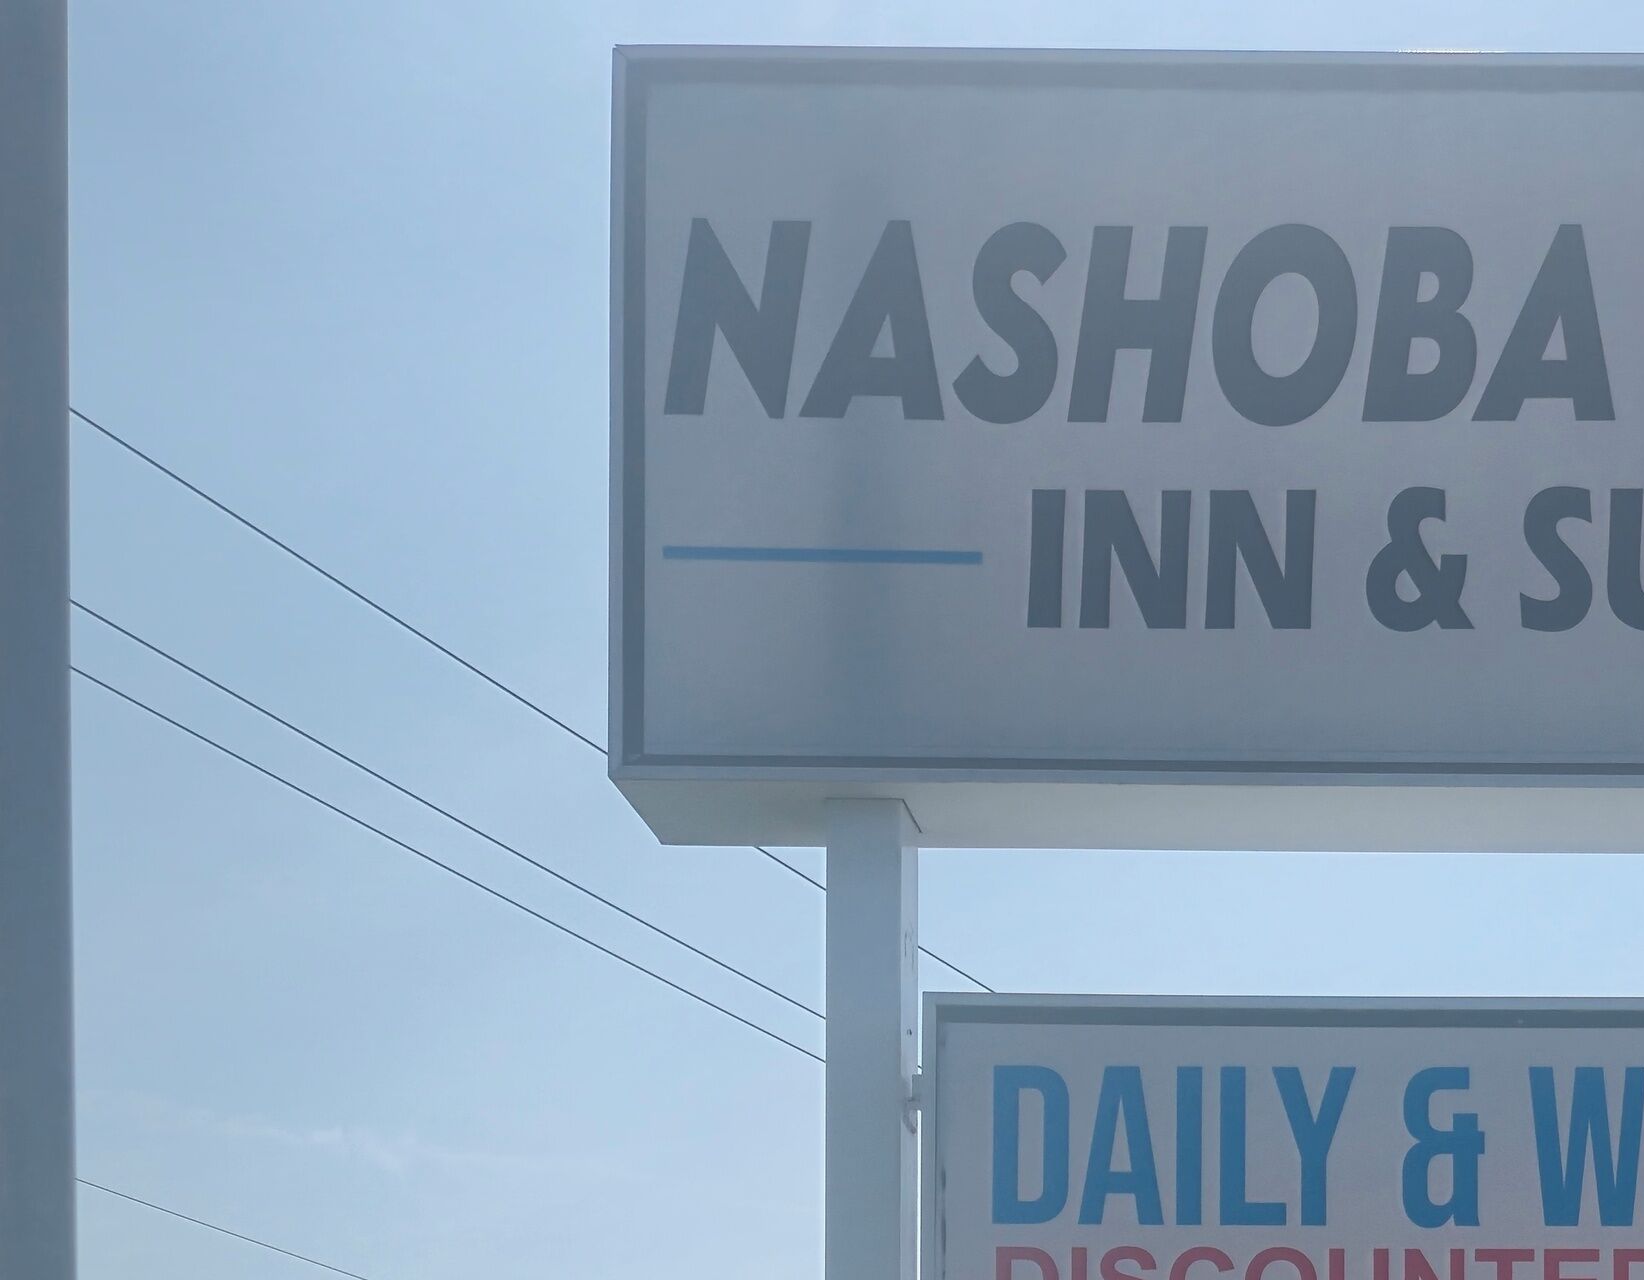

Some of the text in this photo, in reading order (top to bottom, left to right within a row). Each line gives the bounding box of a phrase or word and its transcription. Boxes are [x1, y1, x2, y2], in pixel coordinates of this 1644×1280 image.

[664, 218, 1616, 427] NASHOBA
[1026, 488, 1316, 630] INN
[1366, 486, 1475, 633] &
[991, 1064, 1356, 1227] DAILY
[1402, 1065, 1485, 1228] &
